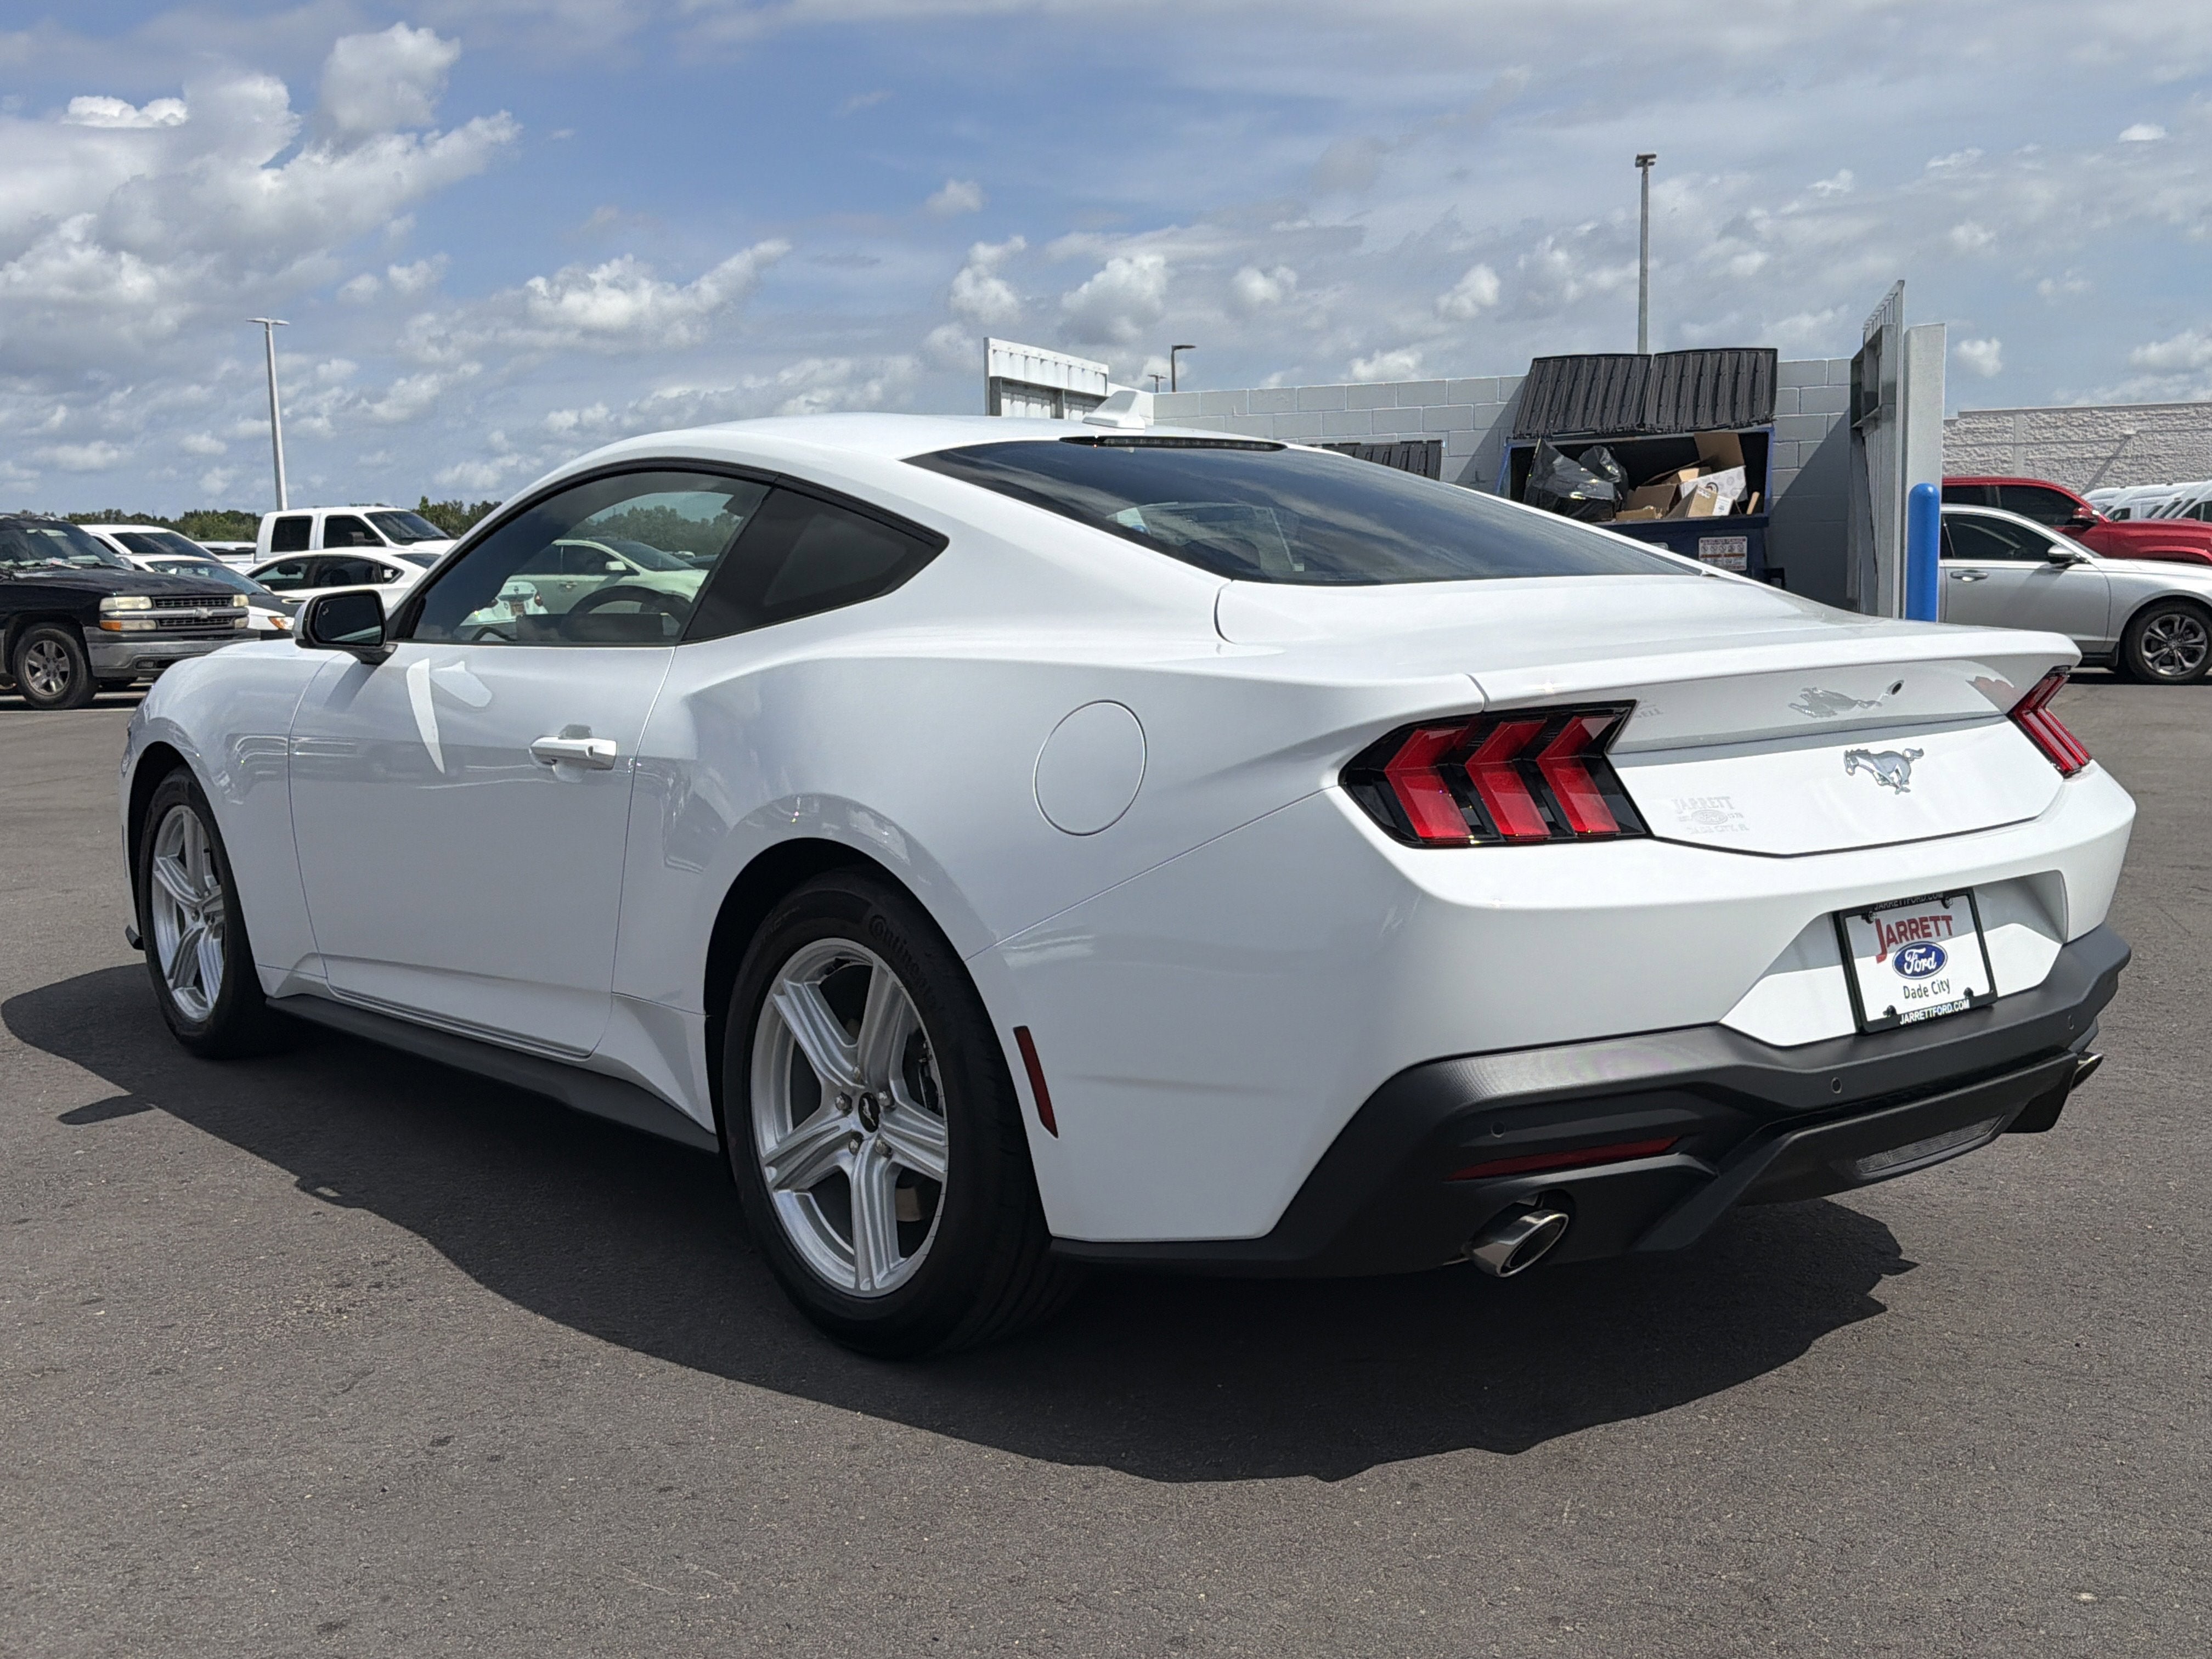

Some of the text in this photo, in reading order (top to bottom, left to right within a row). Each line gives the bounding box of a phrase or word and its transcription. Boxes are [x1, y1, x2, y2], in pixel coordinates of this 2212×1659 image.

[1875, 915, 1953, 964] JARRETT
[1903, 947, 1938, 975] Ford
[1903, 978, 1951, 1000] Dade City
[1899, 998, 1970, 1025] JARRETTFORD.COM
